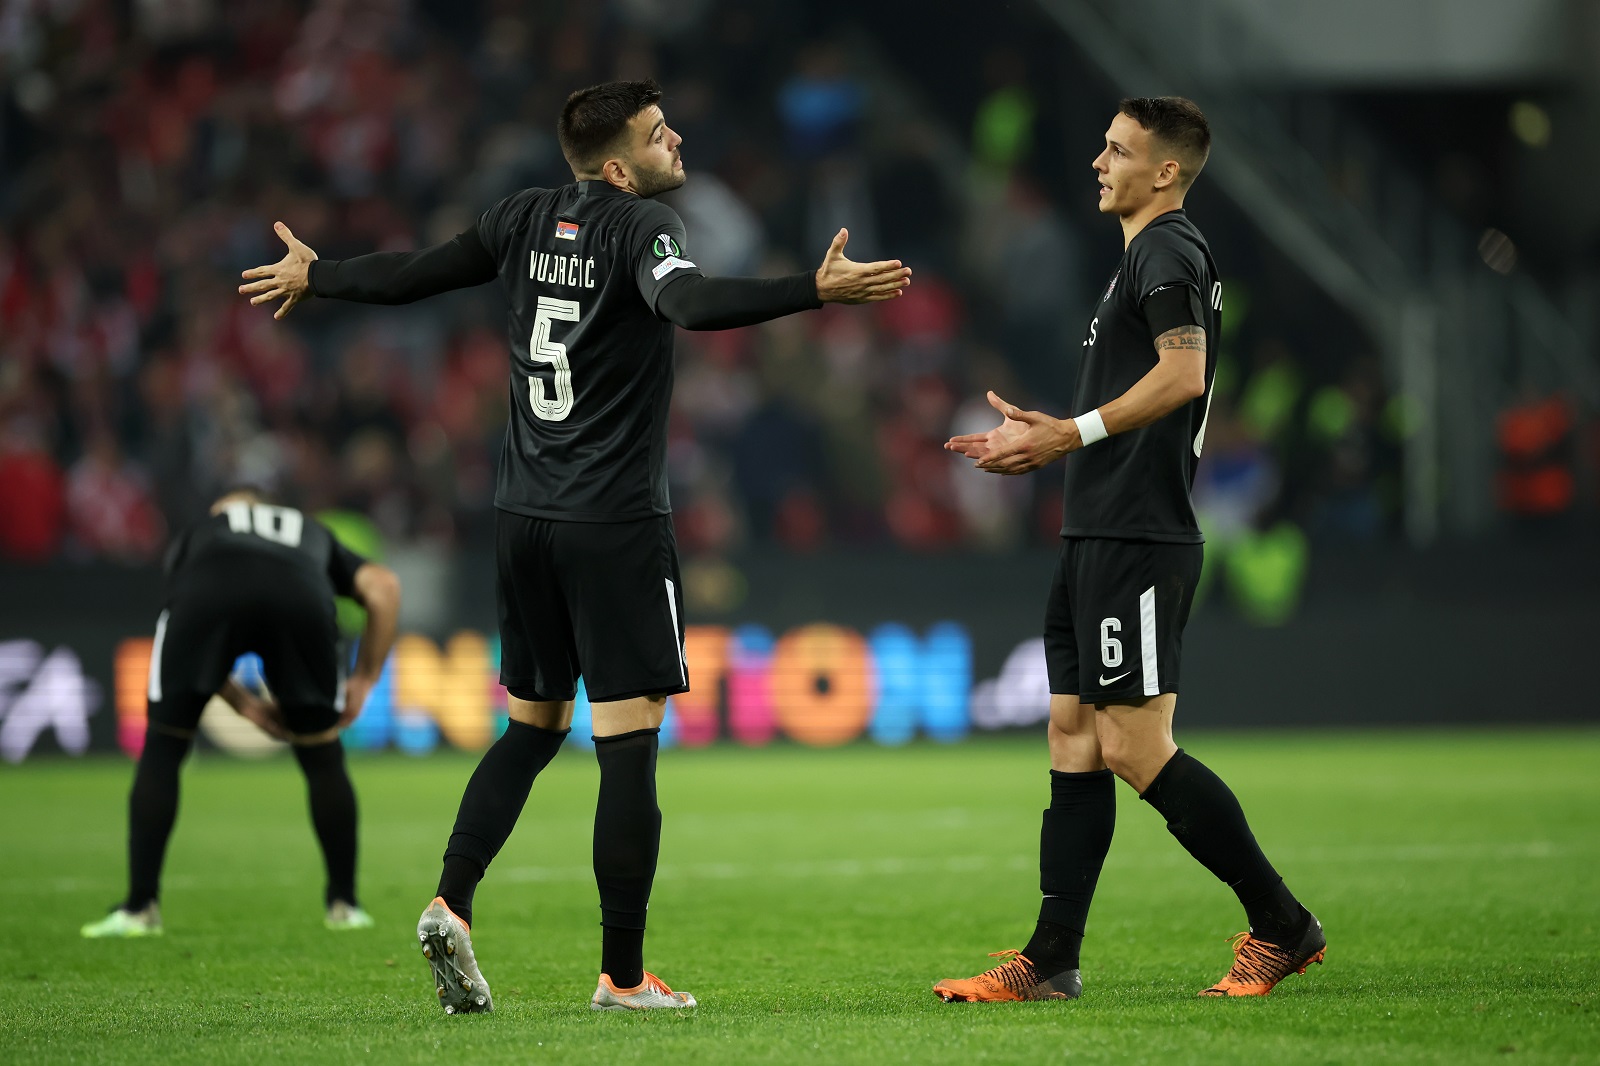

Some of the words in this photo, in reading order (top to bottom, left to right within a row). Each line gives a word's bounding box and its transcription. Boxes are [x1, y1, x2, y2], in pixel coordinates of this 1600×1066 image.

[529, 250, 595, 288] VUJAČIĆ
[528, 296, 580, 421] 5
[221, 500, 303, 548] 10
[1101, 617, 1123, 667] 6
